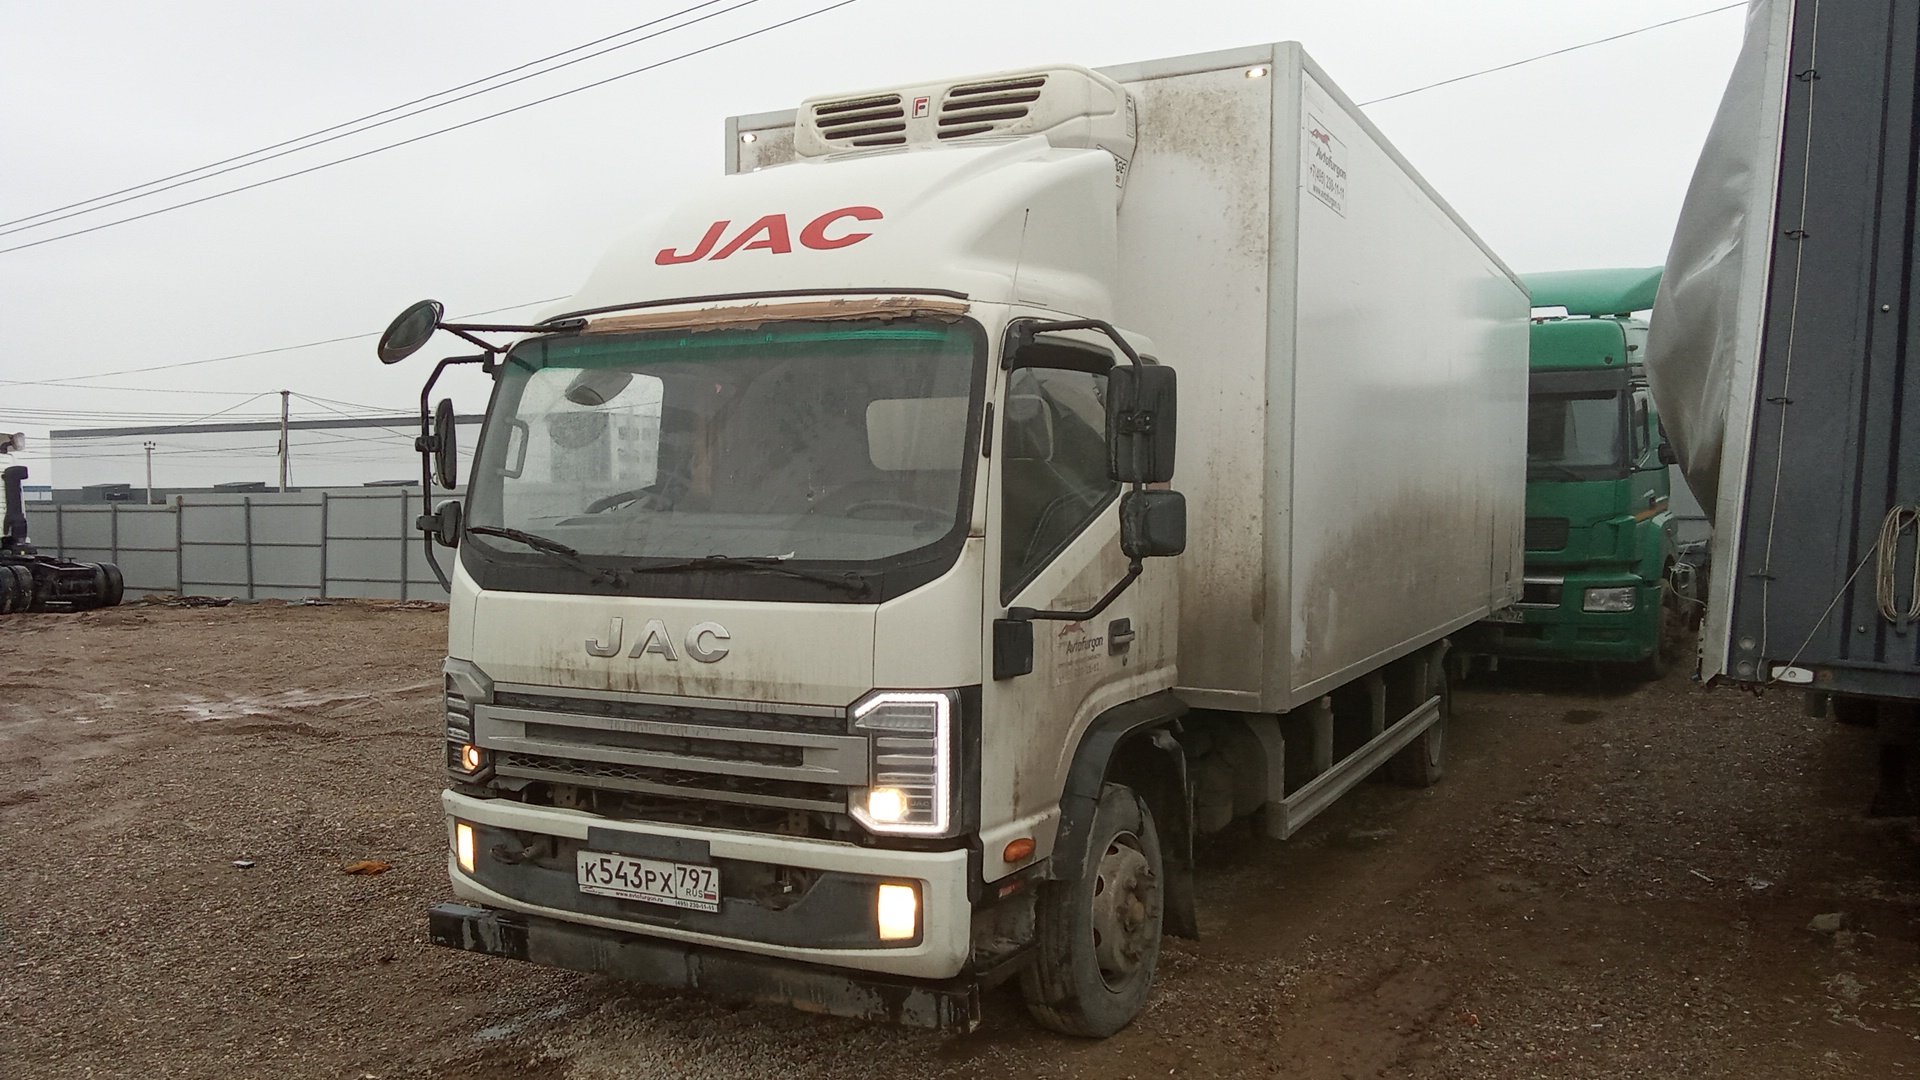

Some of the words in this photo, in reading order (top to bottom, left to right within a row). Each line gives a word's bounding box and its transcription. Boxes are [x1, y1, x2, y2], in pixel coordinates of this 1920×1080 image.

[655, 206, 884, 265] JAC
[585, 616, 731, 664] JAC
[1066, 636, 1104, 656] Avtofurgon
[677, 866, 713, 892] 797
[685, 887, 704, 899] RUS
